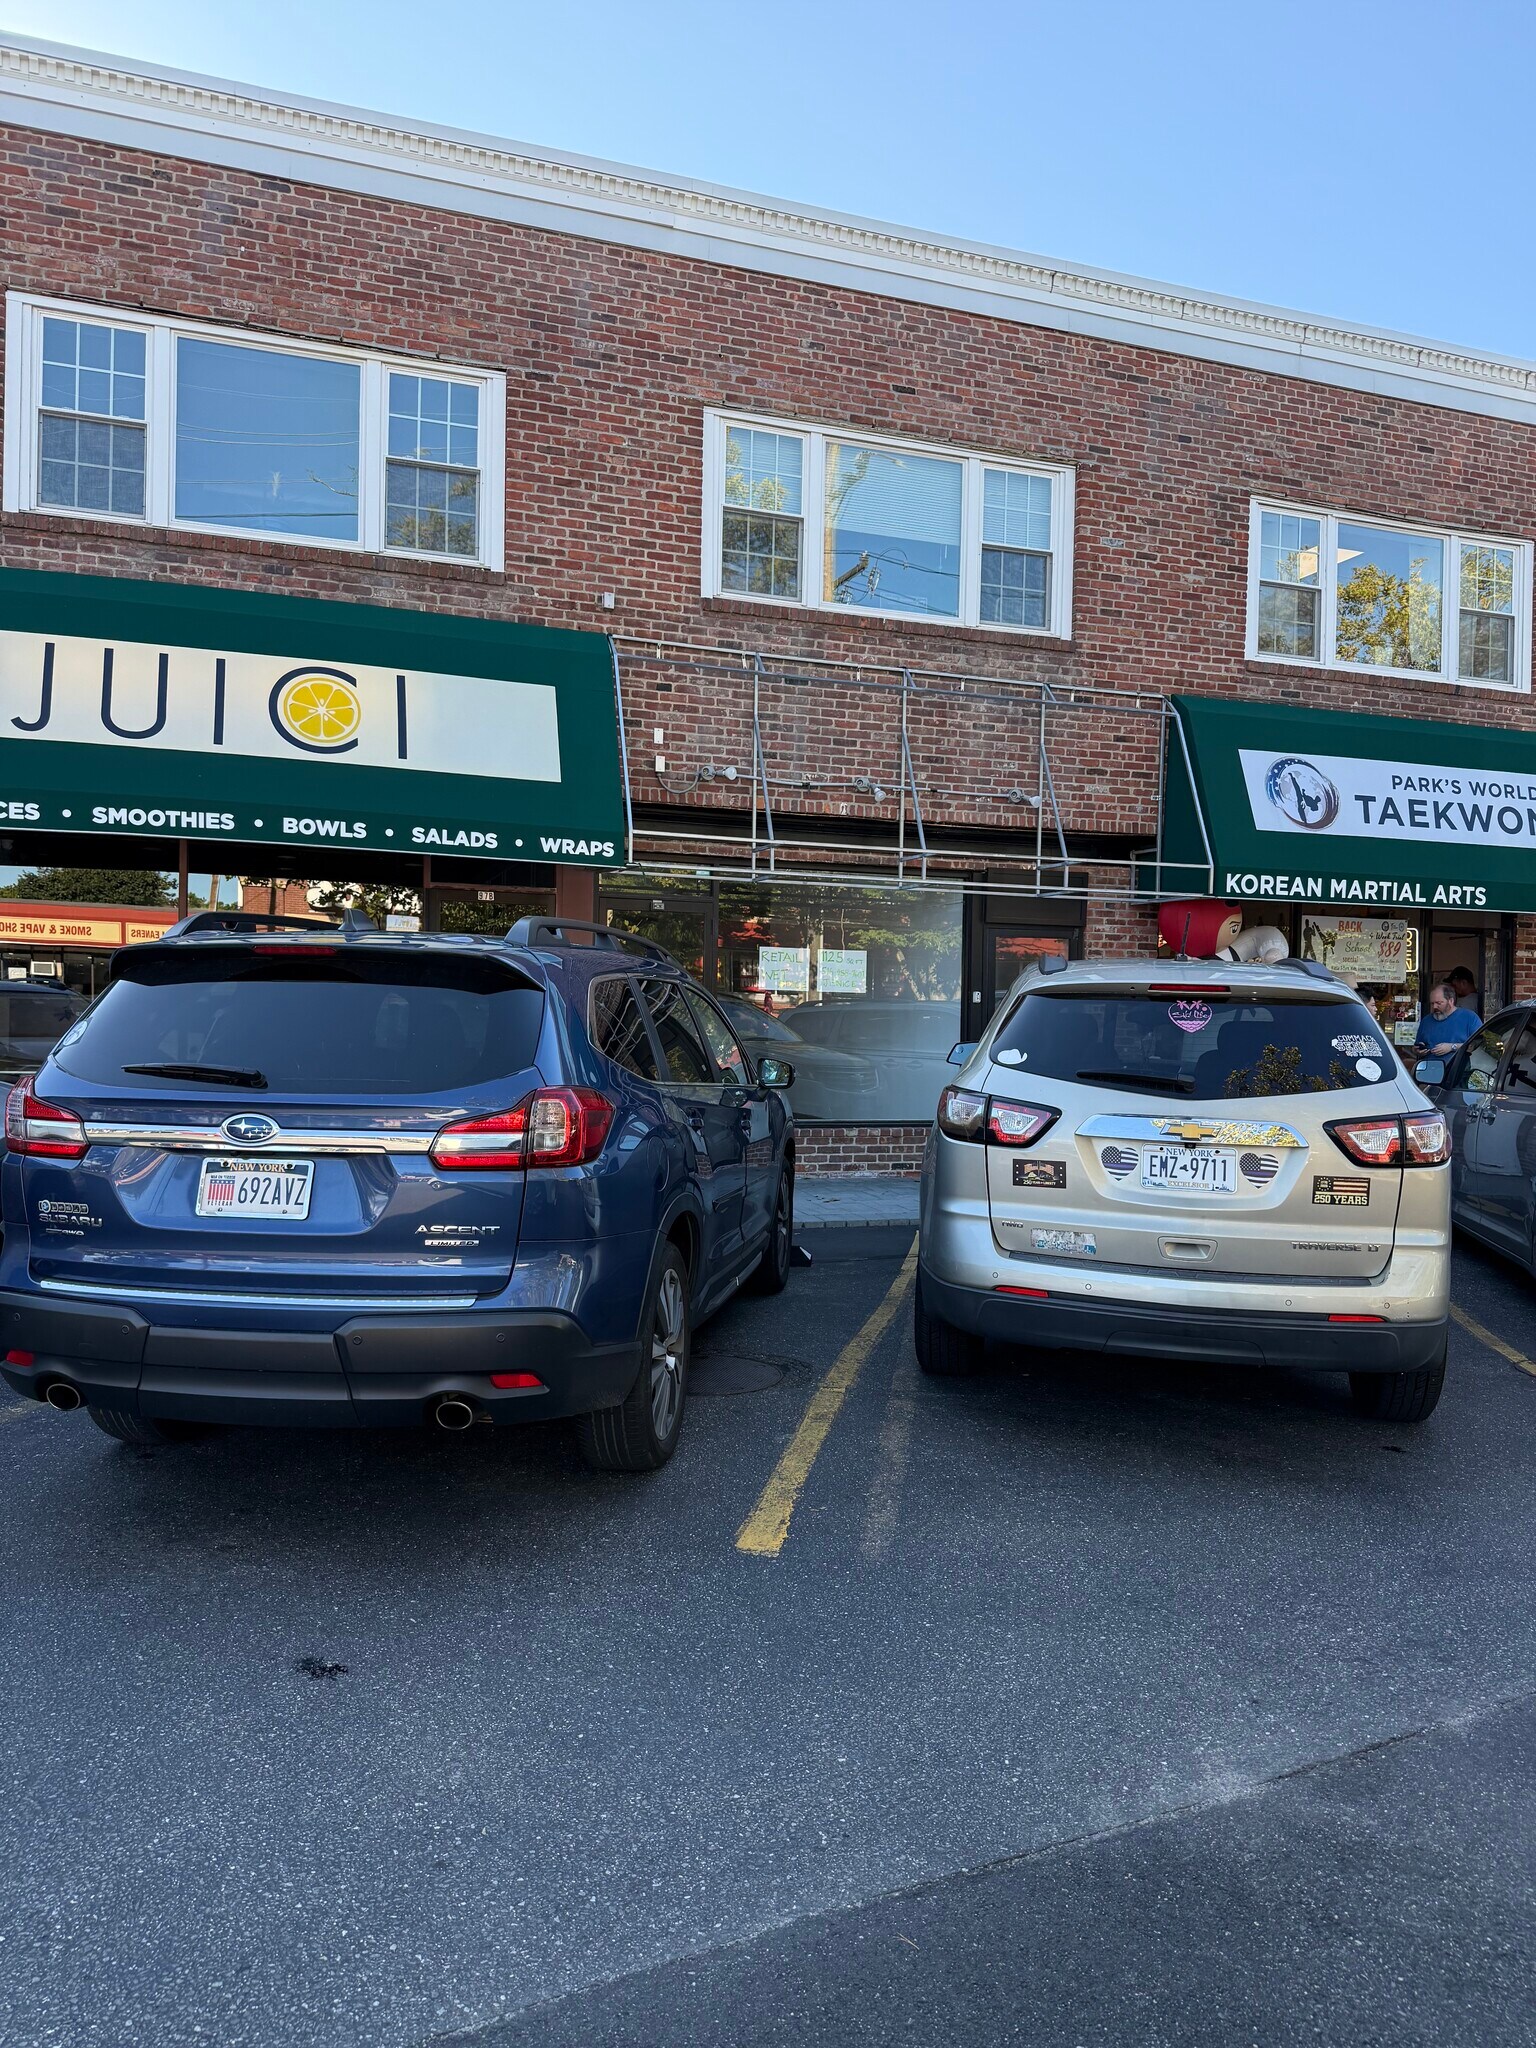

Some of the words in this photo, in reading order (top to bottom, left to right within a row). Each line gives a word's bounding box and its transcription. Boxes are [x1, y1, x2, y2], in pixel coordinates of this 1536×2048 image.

[10, 641, 408, 760] JUICI
[92, 806, 235, 831] SMOOTHIES
[282, 817, 367, 839] BOWLS
[411, 826, 498, 849] SALADS
[539, 836, 615, 858] WRAPS
[1225, 873, 1323, 898] KOREAN
[1330, 879, 1427, 903] MARTIAL
[1432, 885, 1487, 906] ARTS
[1338, 920, 1362, 933] BACK
[1345, 942, 1373, 954] School
[1378, 941, 1402, 958] $89
[761, 951, 803, 963] RETAIL
[822, 951, 844, 963] 1125
[1166, 1147, 1186, 1156] NEW
[1189, 1149, 1213, 1158] YORK
[230, 1163, 256, 1172] NEW
[258, 1164, 286, 1173] YORK
[238, 1177, 307, 1206] 692AVZ
[1314, 1194, 1331, 1204] 250
[1333, 1195, 1368, 1205] YEARS
[39, 1213, 103, 1227] SUBARU
[414, 1224, 500, 1236] ASCENT
[1291, 1241, 1362, 1252] TRAVERSE
